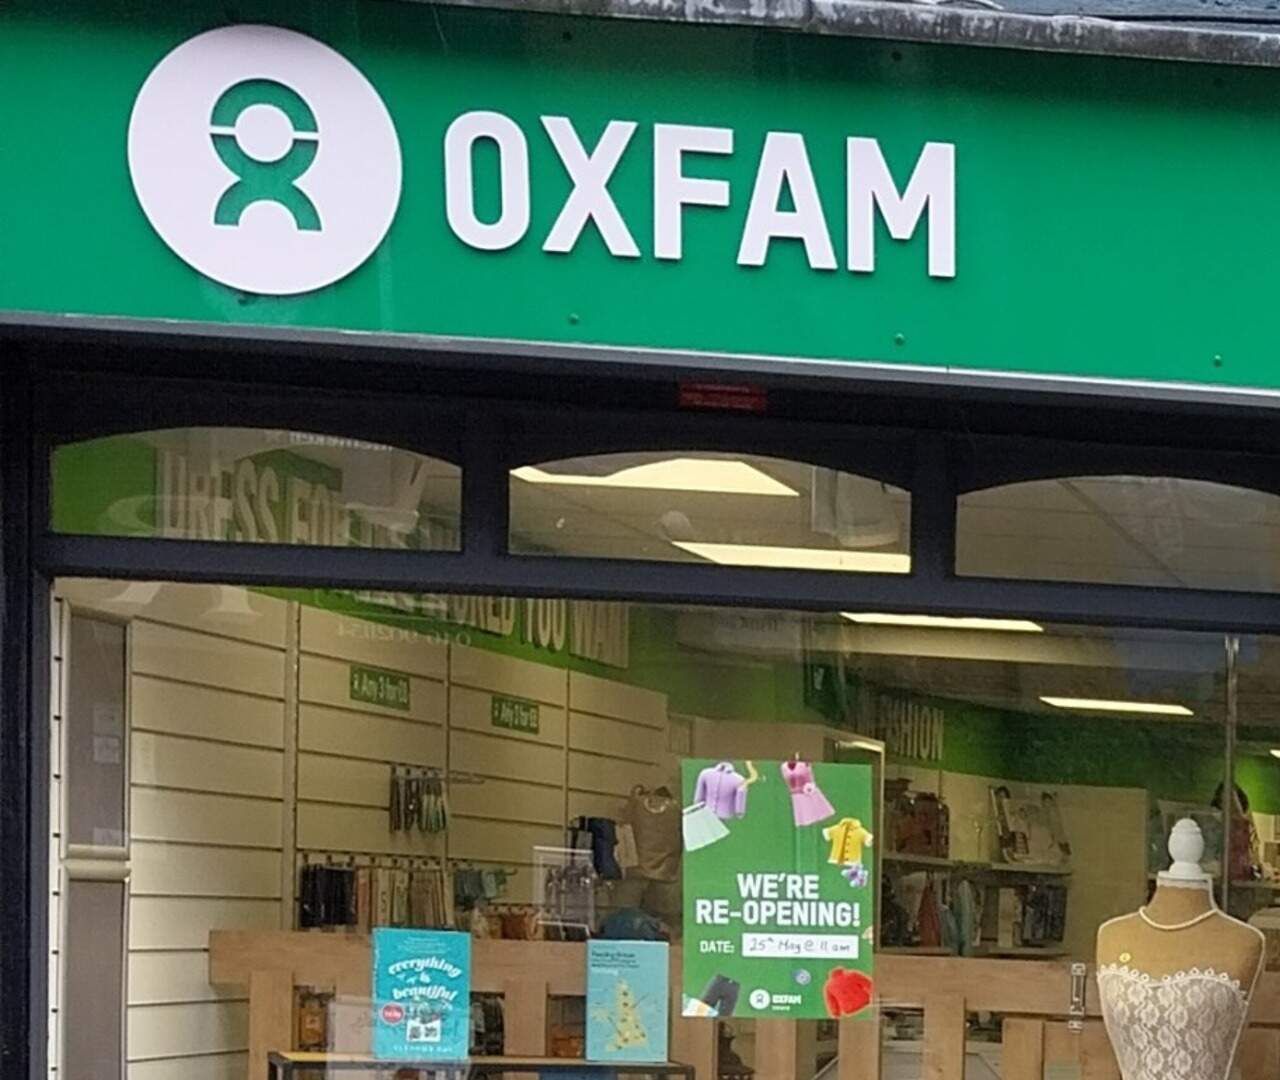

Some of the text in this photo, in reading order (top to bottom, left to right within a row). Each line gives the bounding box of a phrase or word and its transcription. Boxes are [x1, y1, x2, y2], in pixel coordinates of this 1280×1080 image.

[443, 109, 957, 279] OXFAM
[736, 873, 820, 900] WE'RE
[695, 898, 861, 928] RE-OPENING!
[699, 940, 735, 954] DATE:
[388, 956, 462, 979] everything
[392, 984, 458, 1001] beautiful
